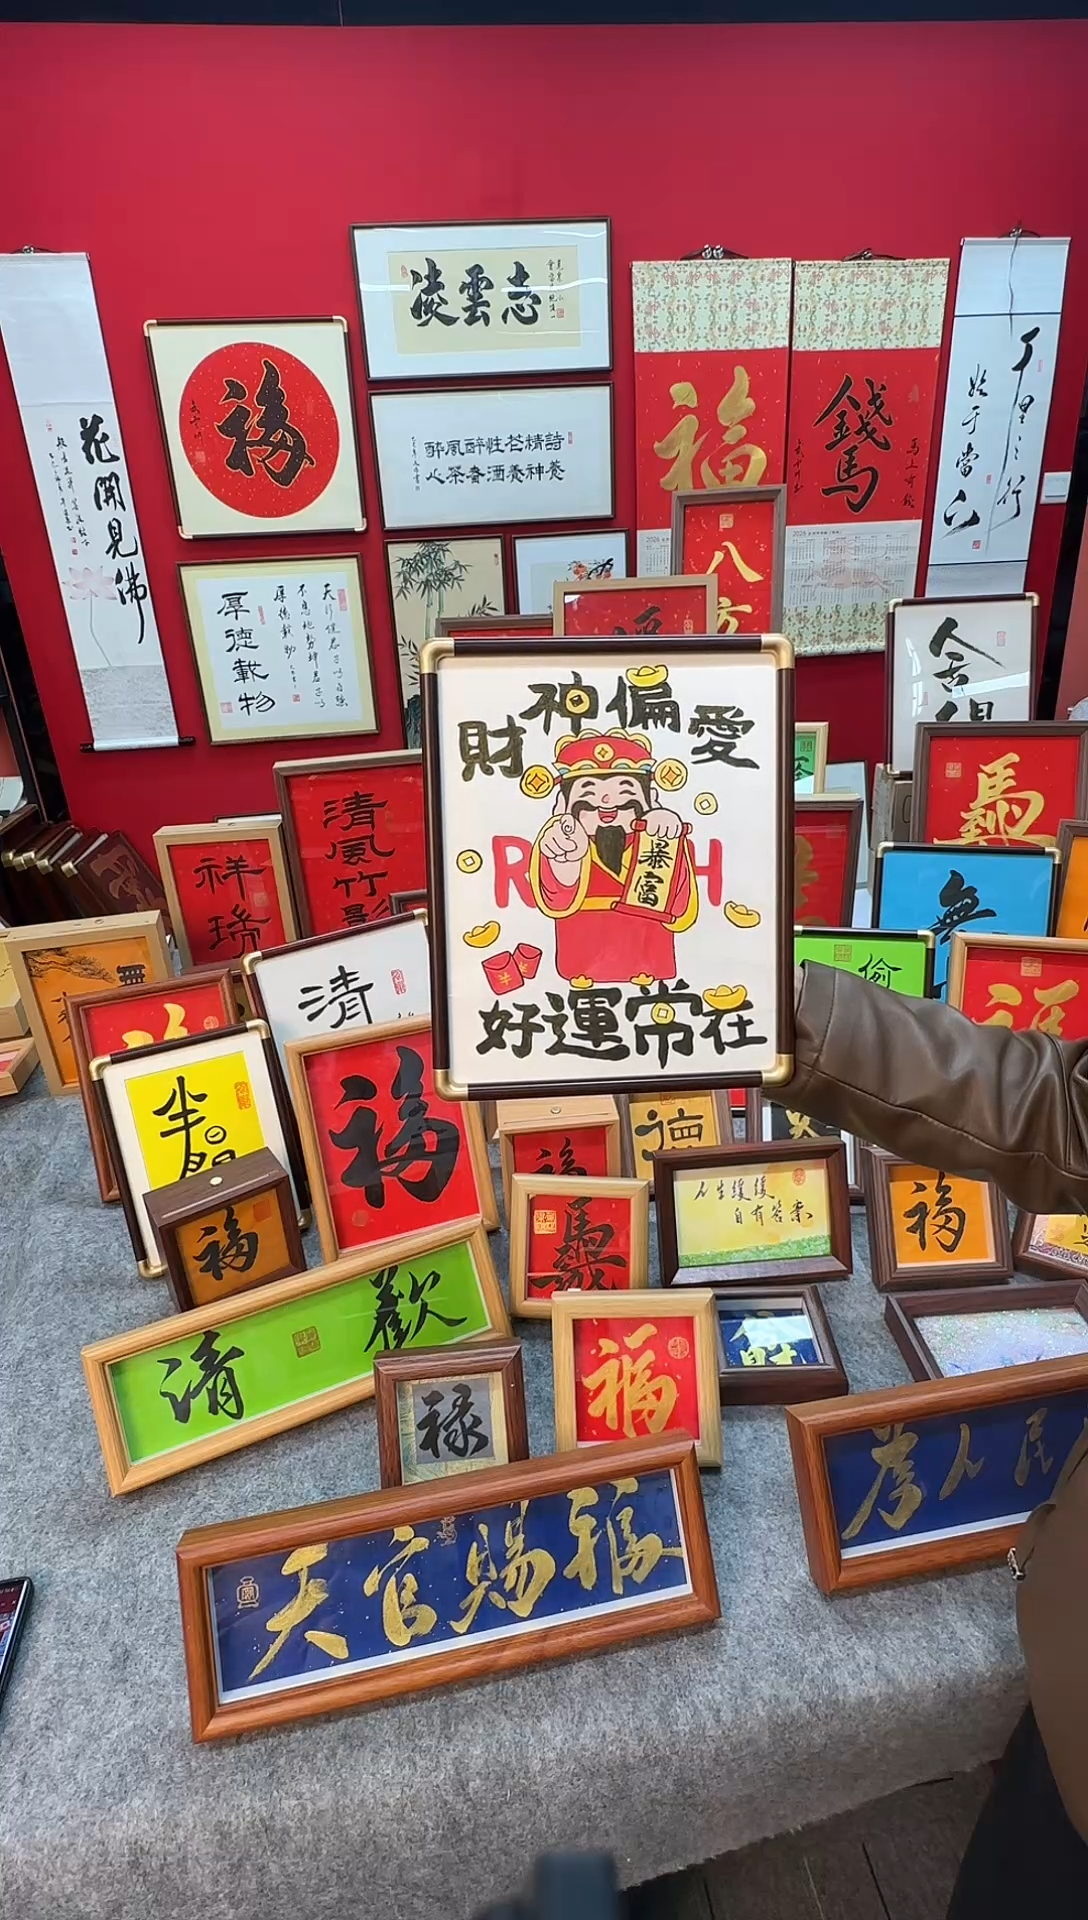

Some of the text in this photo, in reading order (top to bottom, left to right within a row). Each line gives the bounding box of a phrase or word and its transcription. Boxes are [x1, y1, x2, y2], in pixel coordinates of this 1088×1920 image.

[653, 365, 767, 491] 福
[193, 855, 270, 958] 祥瑞
[634, 839, 673, 907] 暴富
[476, 978, 768, 1069] 好運常在
[194, 1206, 259, 1281] 福
[903, 1170, 966, 1253] 福
[583, 1323, 677, 1439] 福
